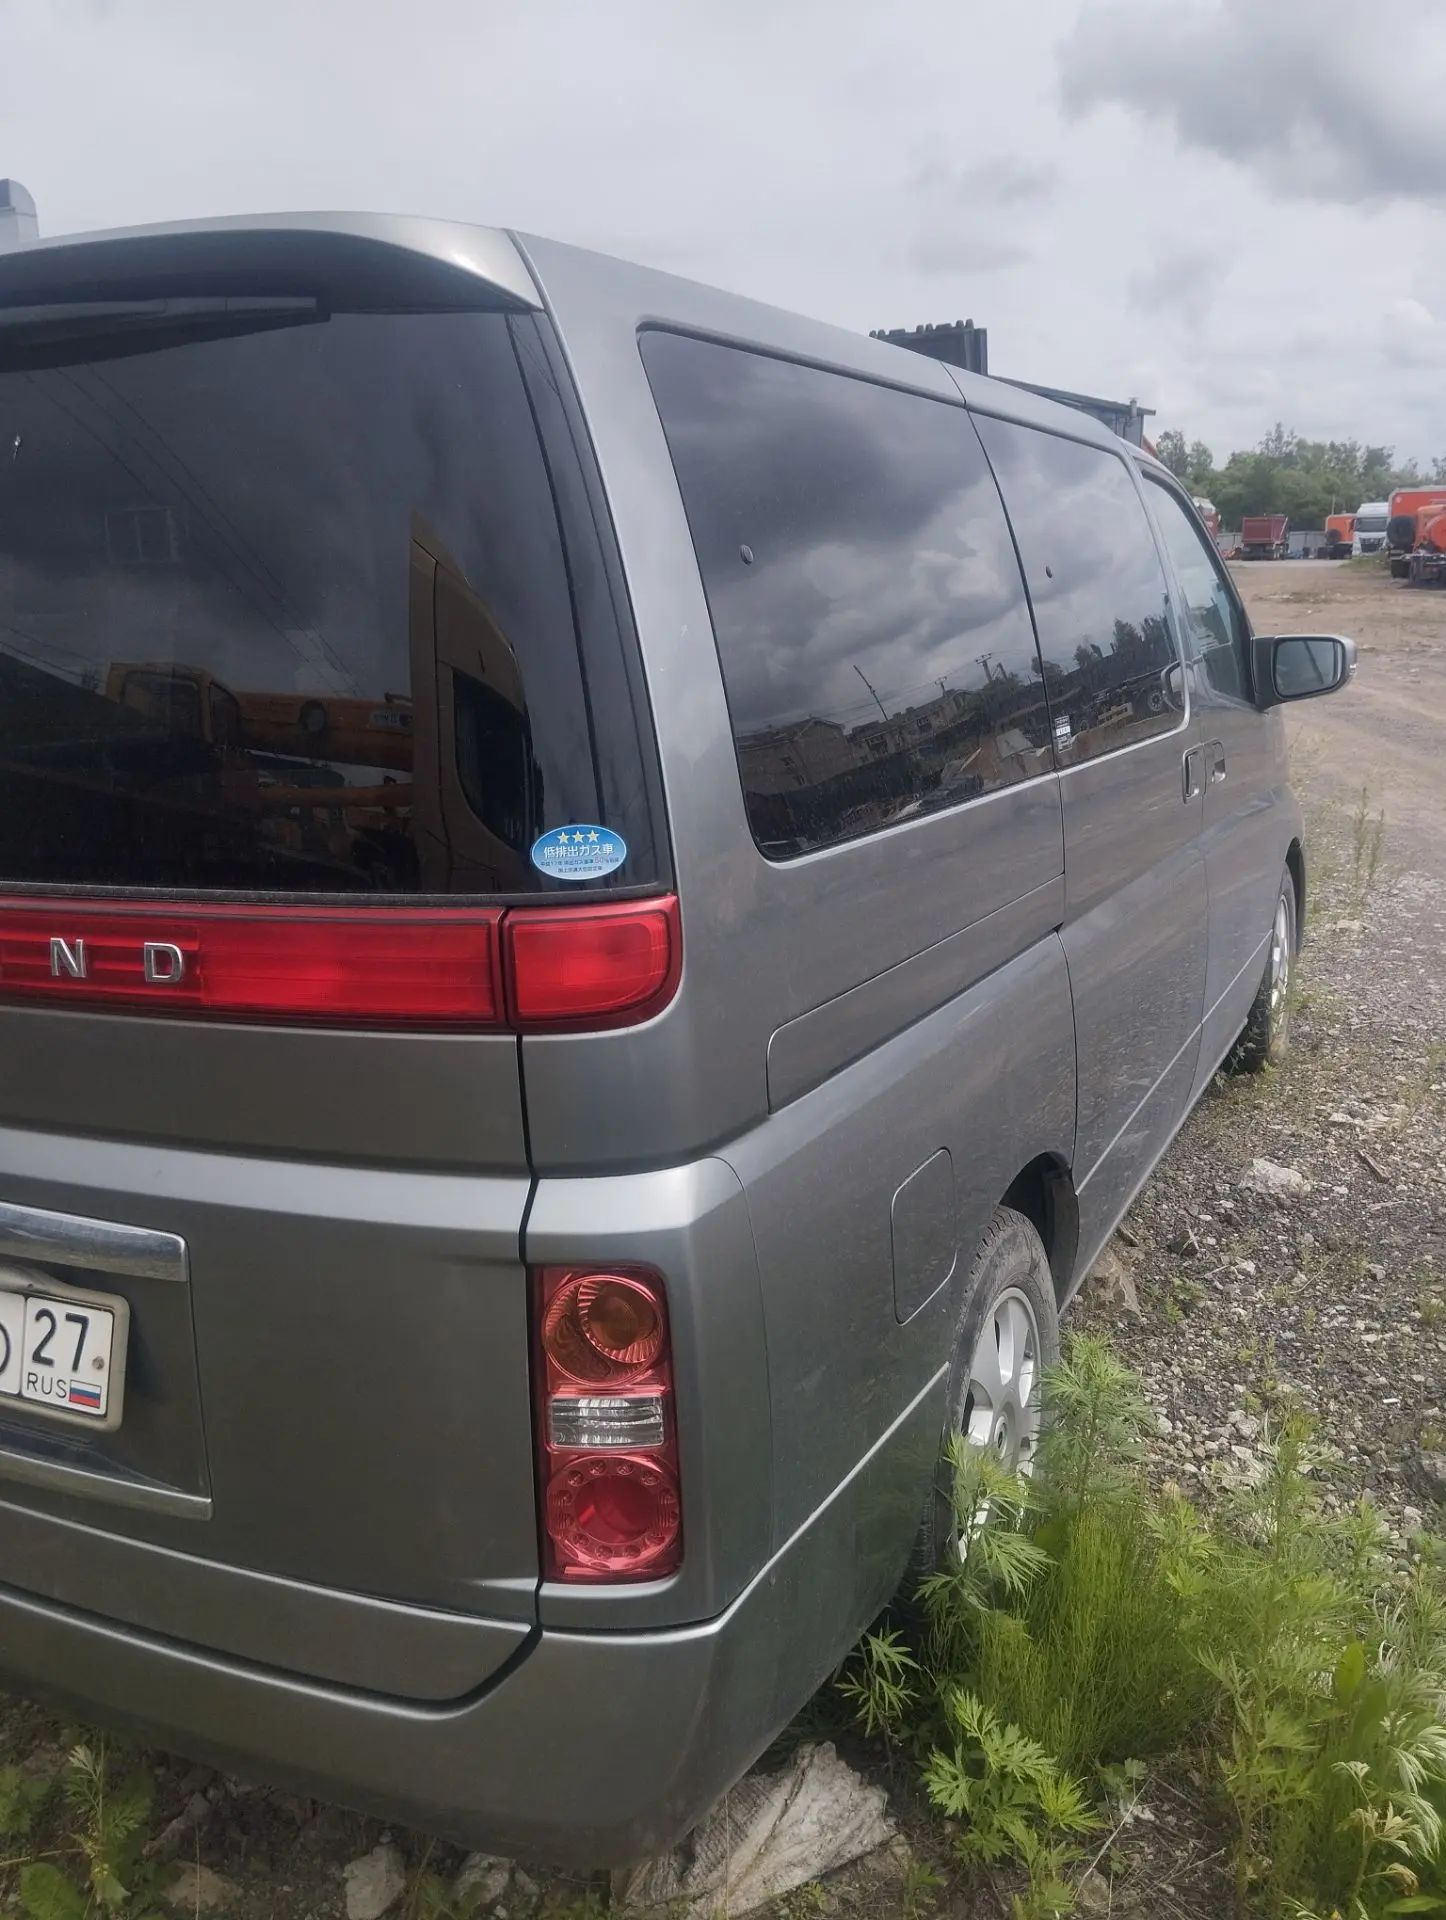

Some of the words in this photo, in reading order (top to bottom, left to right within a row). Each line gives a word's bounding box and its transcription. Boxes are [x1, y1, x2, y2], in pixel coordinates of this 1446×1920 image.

[543, 842, 614, 859] 低排出ガス車
[31, 1307, 90, 1373] 27
[26, 1372, 68, 1399] RUS
